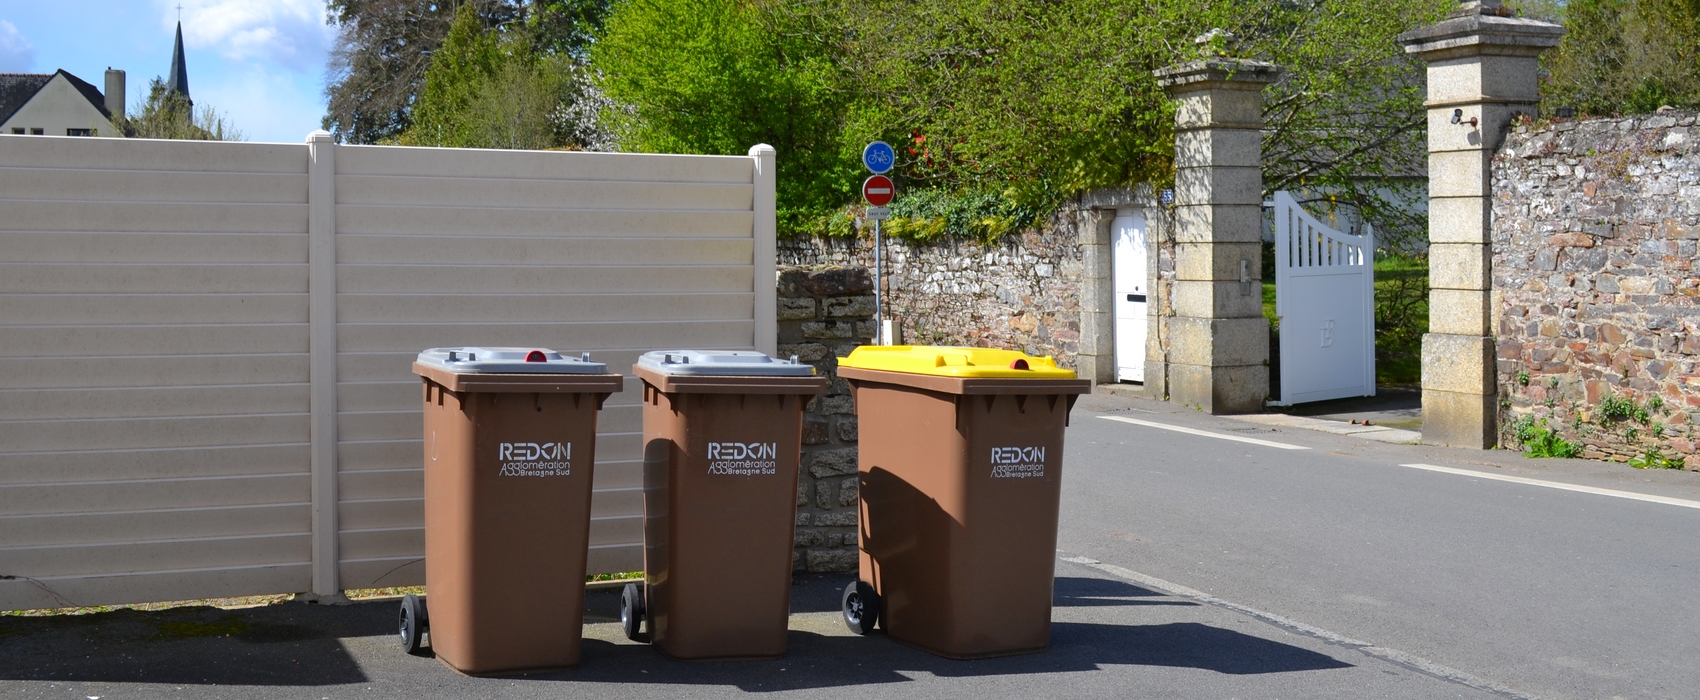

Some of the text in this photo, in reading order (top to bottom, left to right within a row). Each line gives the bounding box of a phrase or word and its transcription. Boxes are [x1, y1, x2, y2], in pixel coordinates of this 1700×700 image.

[499, 442, 571, 460] REDON
[707, 442, 776, 459] REDON
[991, 446, 1045, 463] REDON
[499, 460, 570, 476] Agglomération
[520, 468, 570, 477] Bretagne Sud
[707, 460, 776, 475] Agglomération
[728, 468, 760, 476] Bretagne
[990, 463, 1044, 478] Agglomération
